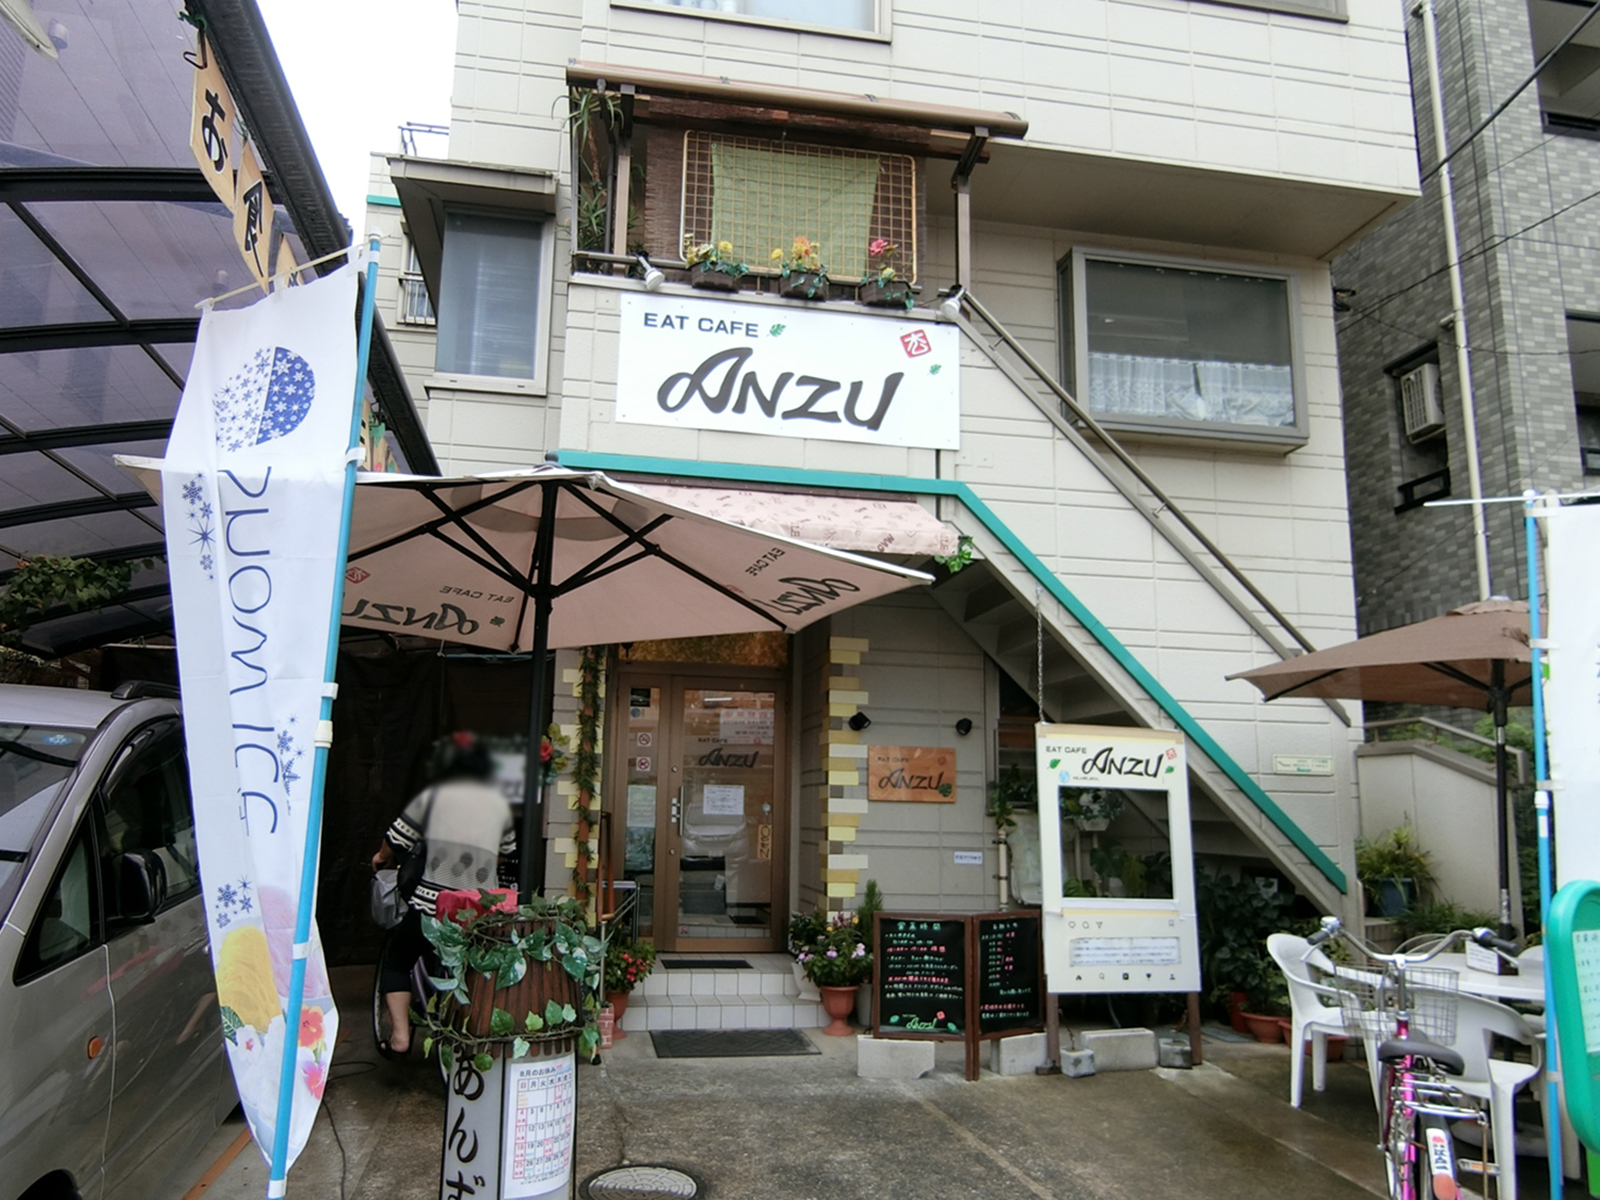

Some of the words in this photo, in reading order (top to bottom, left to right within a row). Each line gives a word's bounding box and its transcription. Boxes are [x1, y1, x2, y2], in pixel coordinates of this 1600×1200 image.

[643, 312, 689, 330] EAT
[698, 317, 759, 338] CAFE
[657, 347, 905, 431] ANZU
[698, 747, 759, 768] ANZU
[1046, 745, 1061, 753] EAT
[1064, 746, 1087, 754] CAFE
[1081, 747, 1164, 778] ANZU
[878, 768, 944, 790] ANZU
